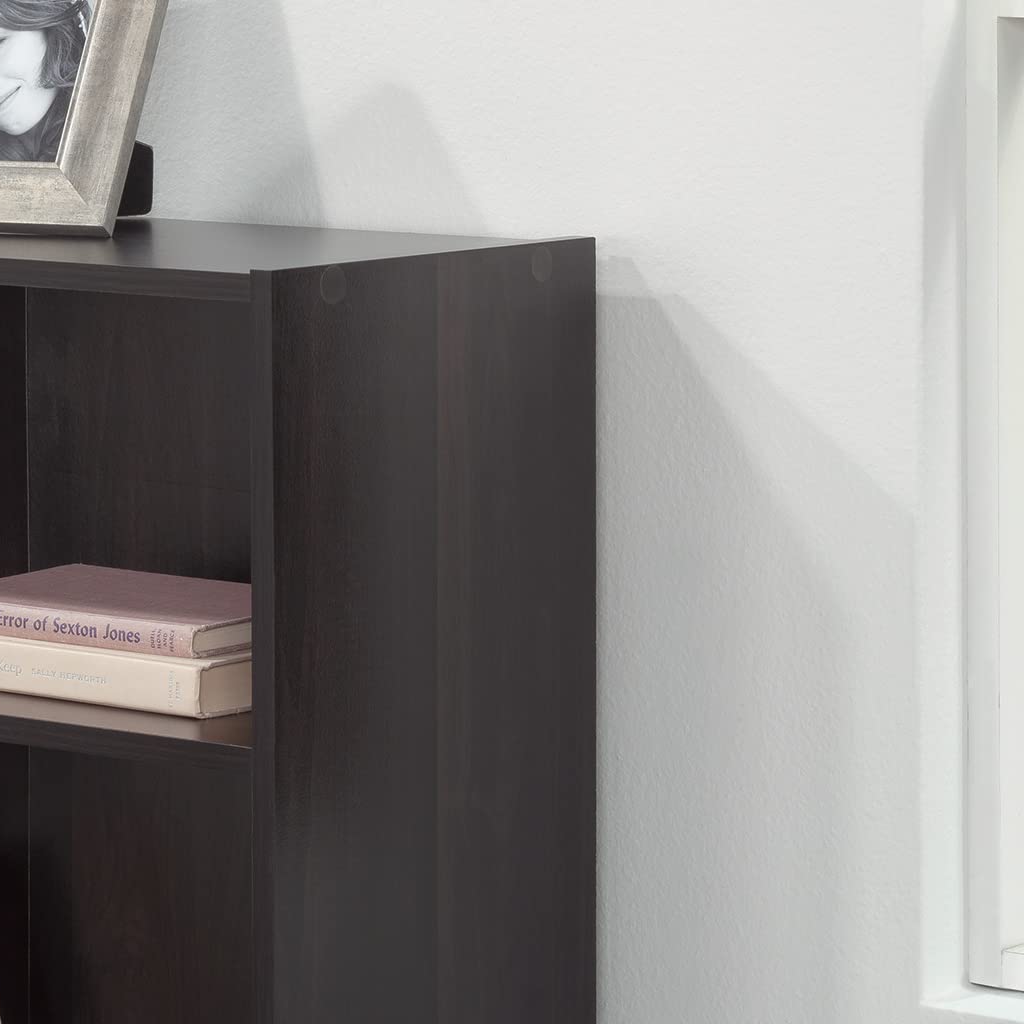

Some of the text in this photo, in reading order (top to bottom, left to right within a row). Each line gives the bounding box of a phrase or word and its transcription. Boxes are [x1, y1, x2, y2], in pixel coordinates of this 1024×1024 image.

[33, 616, 49, 632] of
[52, 617, 98, 639] Sexton
[102, 623, 141, 644] Jones
[31, 667, 56, 678] SALLY
[59, 671, 107, 684] HEPWORTH
